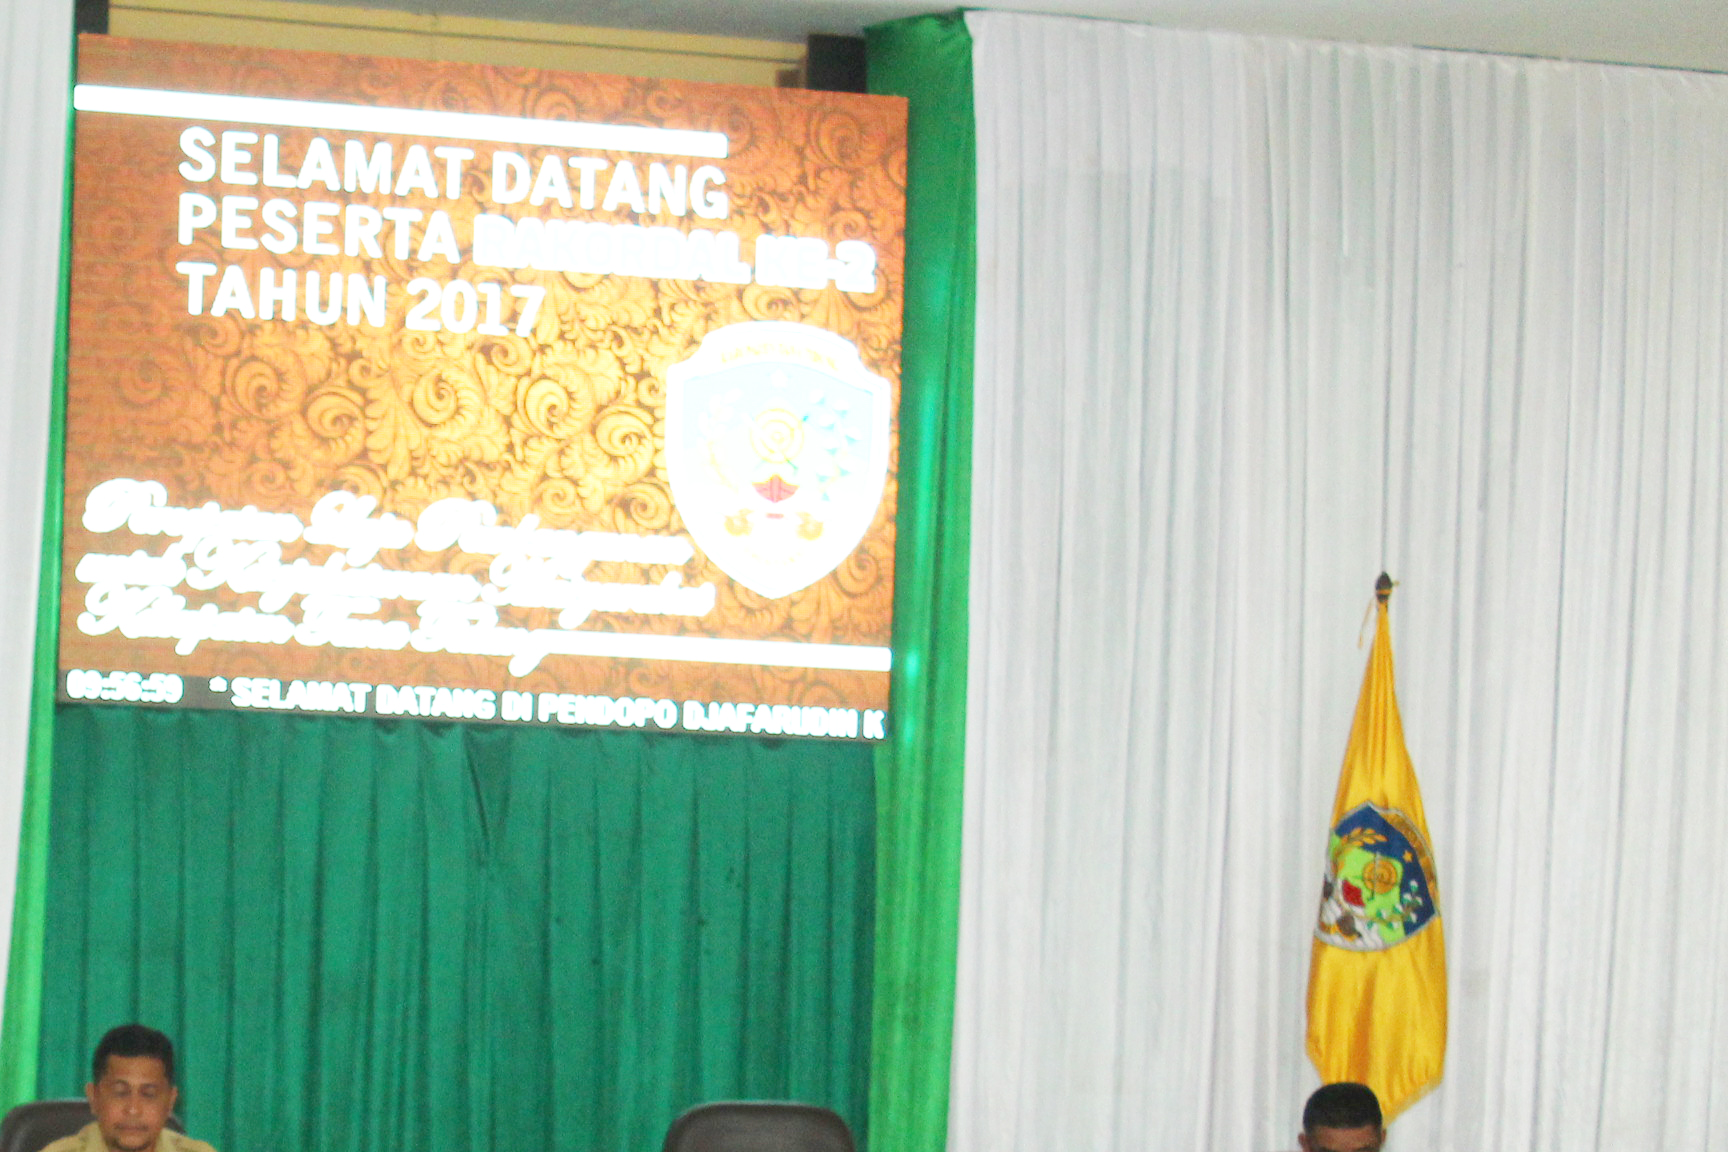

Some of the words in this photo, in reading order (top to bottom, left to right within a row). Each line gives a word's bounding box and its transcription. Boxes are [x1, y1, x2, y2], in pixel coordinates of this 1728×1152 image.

[178, 126, 474, 200] SELAMAT
[491, 150, 729, 220] DATANG
[178, 192, 462, 264] PESERTA
[175, 261, 387, 328] TAHUN
[404, 277, 547, 337] 2017
[231, 677, 372, 712] SELAMAT
[376, 685, 496, 719] DATANG
[502, 691, 532, 721] DI
[538, 693, 677, 729] PENDOPO
